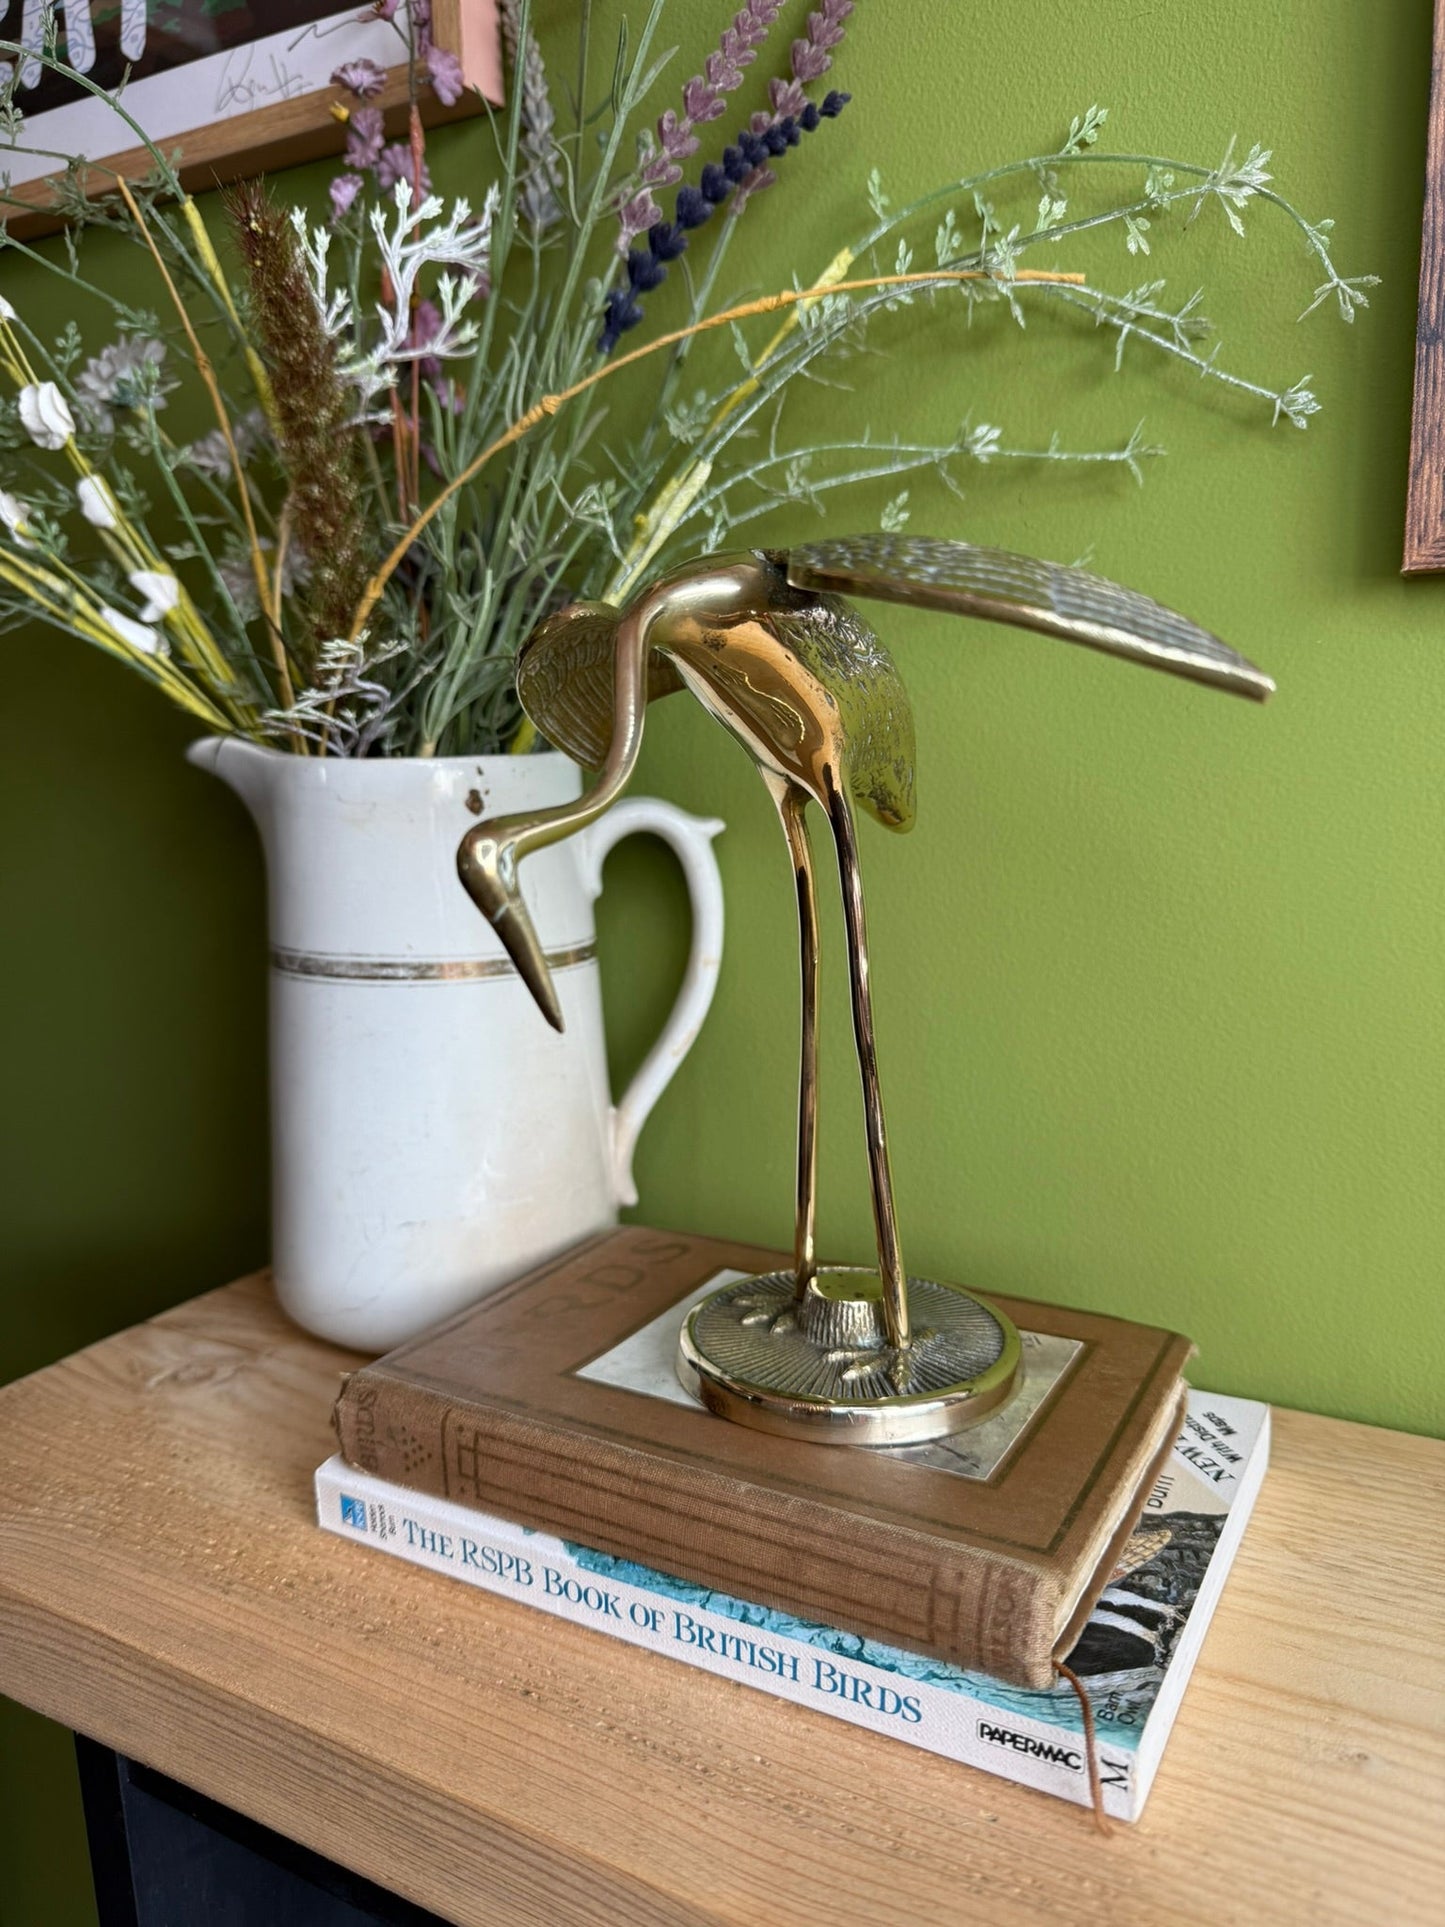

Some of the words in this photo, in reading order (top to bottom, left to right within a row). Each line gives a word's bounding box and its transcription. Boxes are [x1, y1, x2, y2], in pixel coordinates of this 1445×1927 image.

[1202, 1411, 1238, 1436] Maps
[1174, 1445, 1236, 1482] NEW
[1210, 1440, 1243, 1463] With
[402, 1518, 454, 1559] THE
[462, 1538, 534, 1586] RSPB
[543, 1566, 622, 1619] BOOK
[629, 1602, 665, 1632] OF
[673, 1610, 800, 1682] BRITISH
[813, 1657, 923, 1724] BIRDS
[979, 1721, 1082, 1771] PAPERMAC
[1099, 1756, 1129, 1792] M
